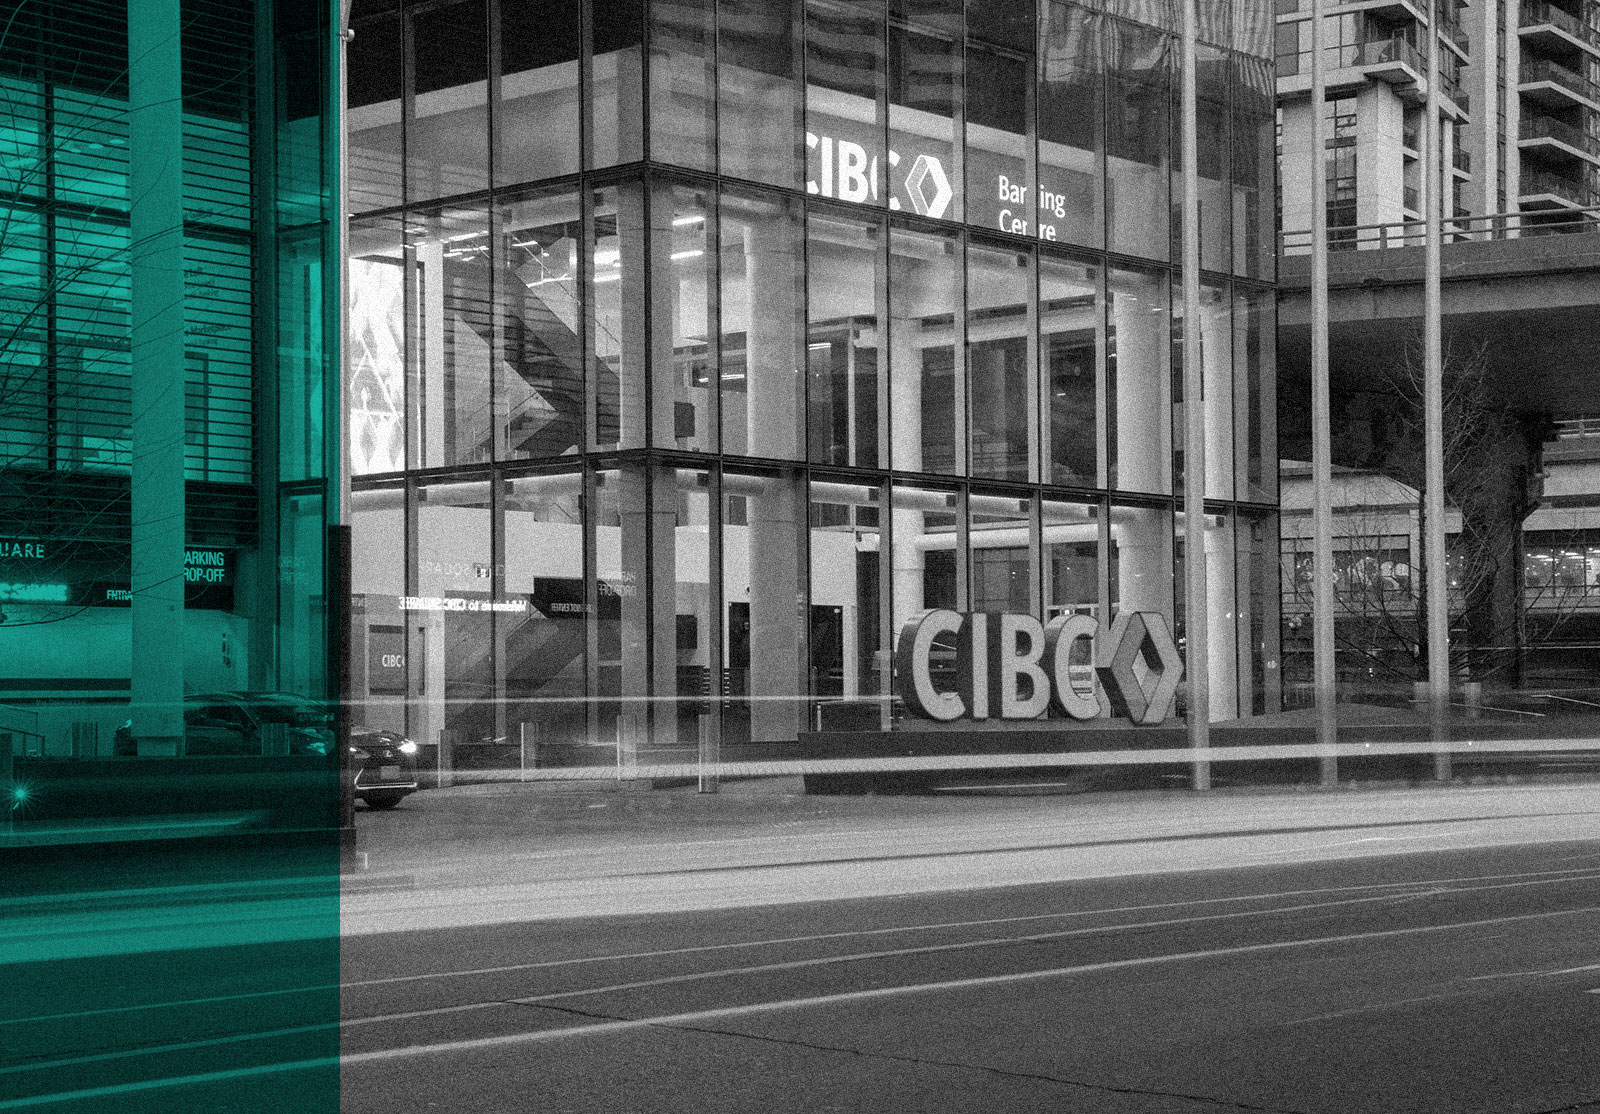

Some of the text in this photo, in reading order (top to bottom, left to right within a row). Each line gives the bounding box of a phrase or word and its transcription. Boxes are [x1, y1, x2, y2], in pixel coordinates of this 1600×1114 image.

[998, 174, 1066, 219] Baning
[998, 208, 1057, 242] Cere
[183, 551, 225, 566] ARKING
[183, 567, 225, 583] ROP-OFF
[106, 589, 133, 601] ENTRA
[382, 654, 402, 668] CIBC
[903, 609, 1101, 720] CIBC
